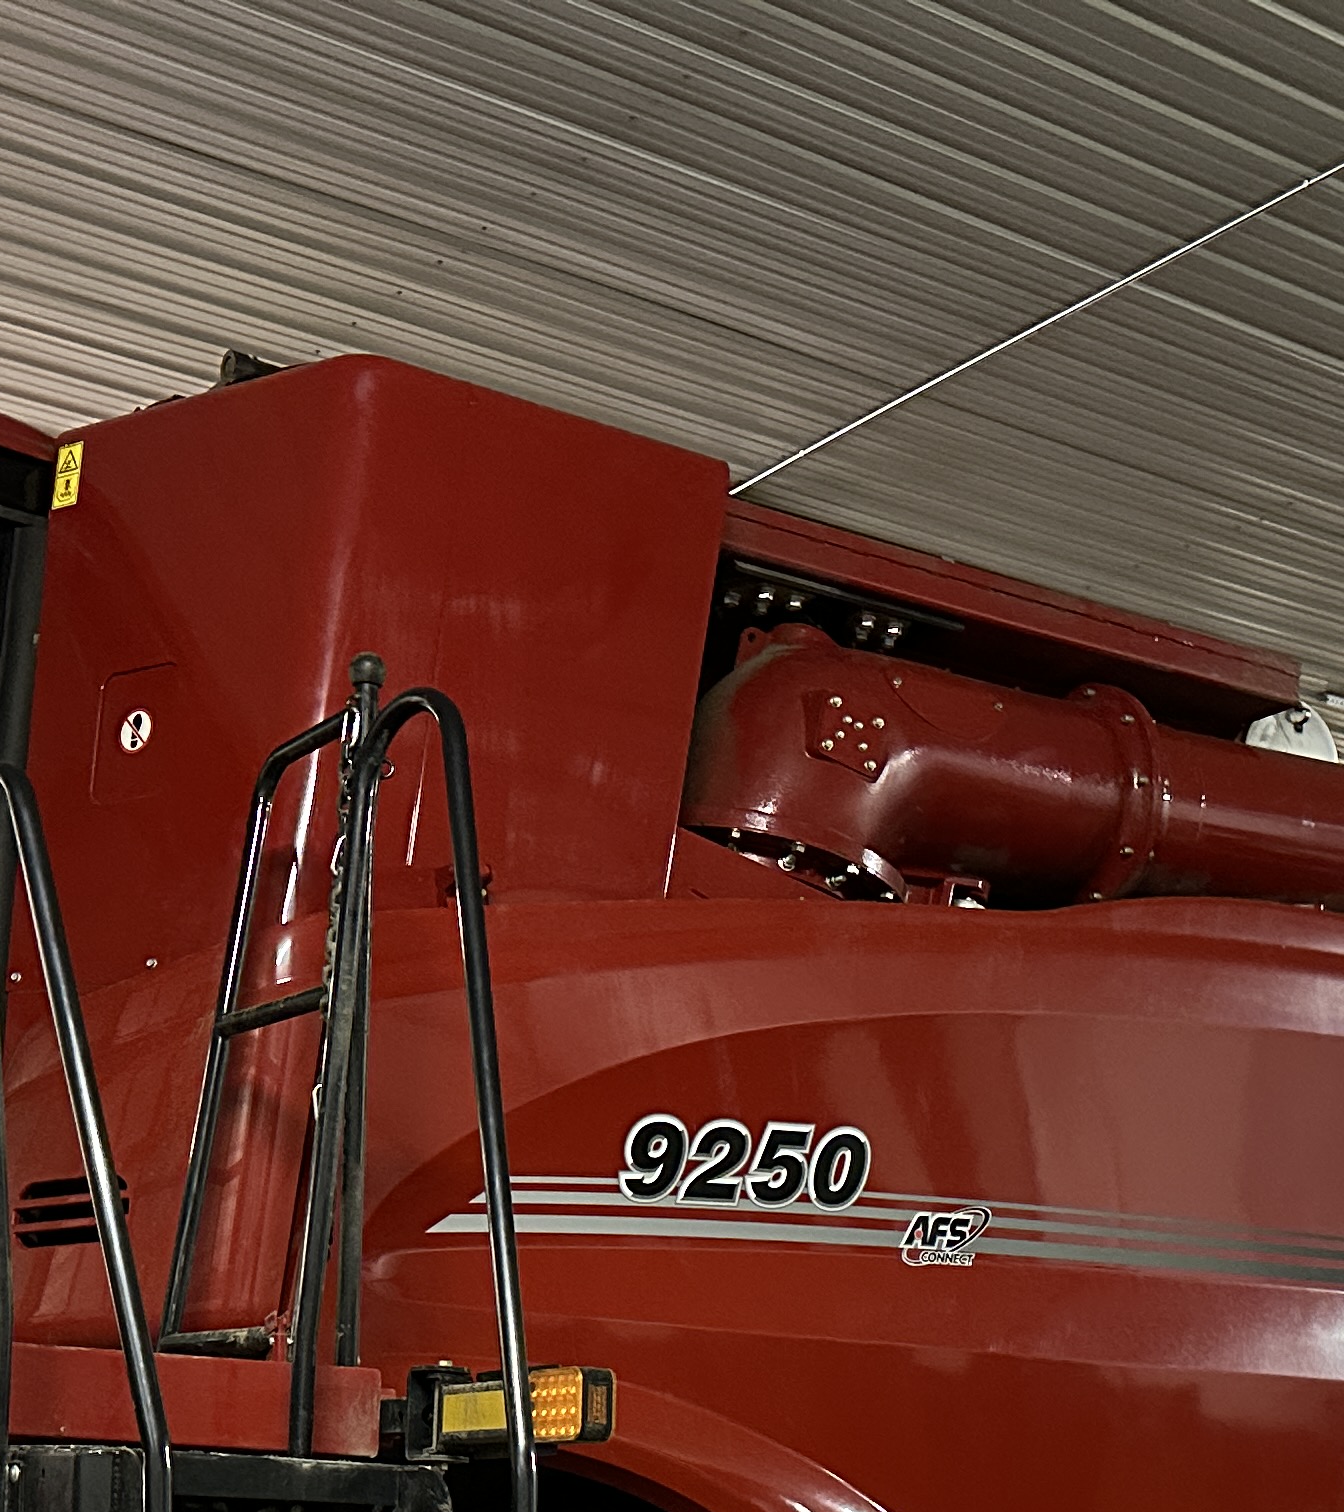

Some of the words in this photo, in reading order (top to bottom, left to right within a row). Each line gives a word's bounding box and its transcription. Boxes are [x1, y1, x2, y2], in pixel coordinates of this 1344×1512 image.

[618, 1114, 872, 1210] 9250
[901, 1212, 973, 1249] AFS
[920, 1251, 974, 1265] CONNECT
